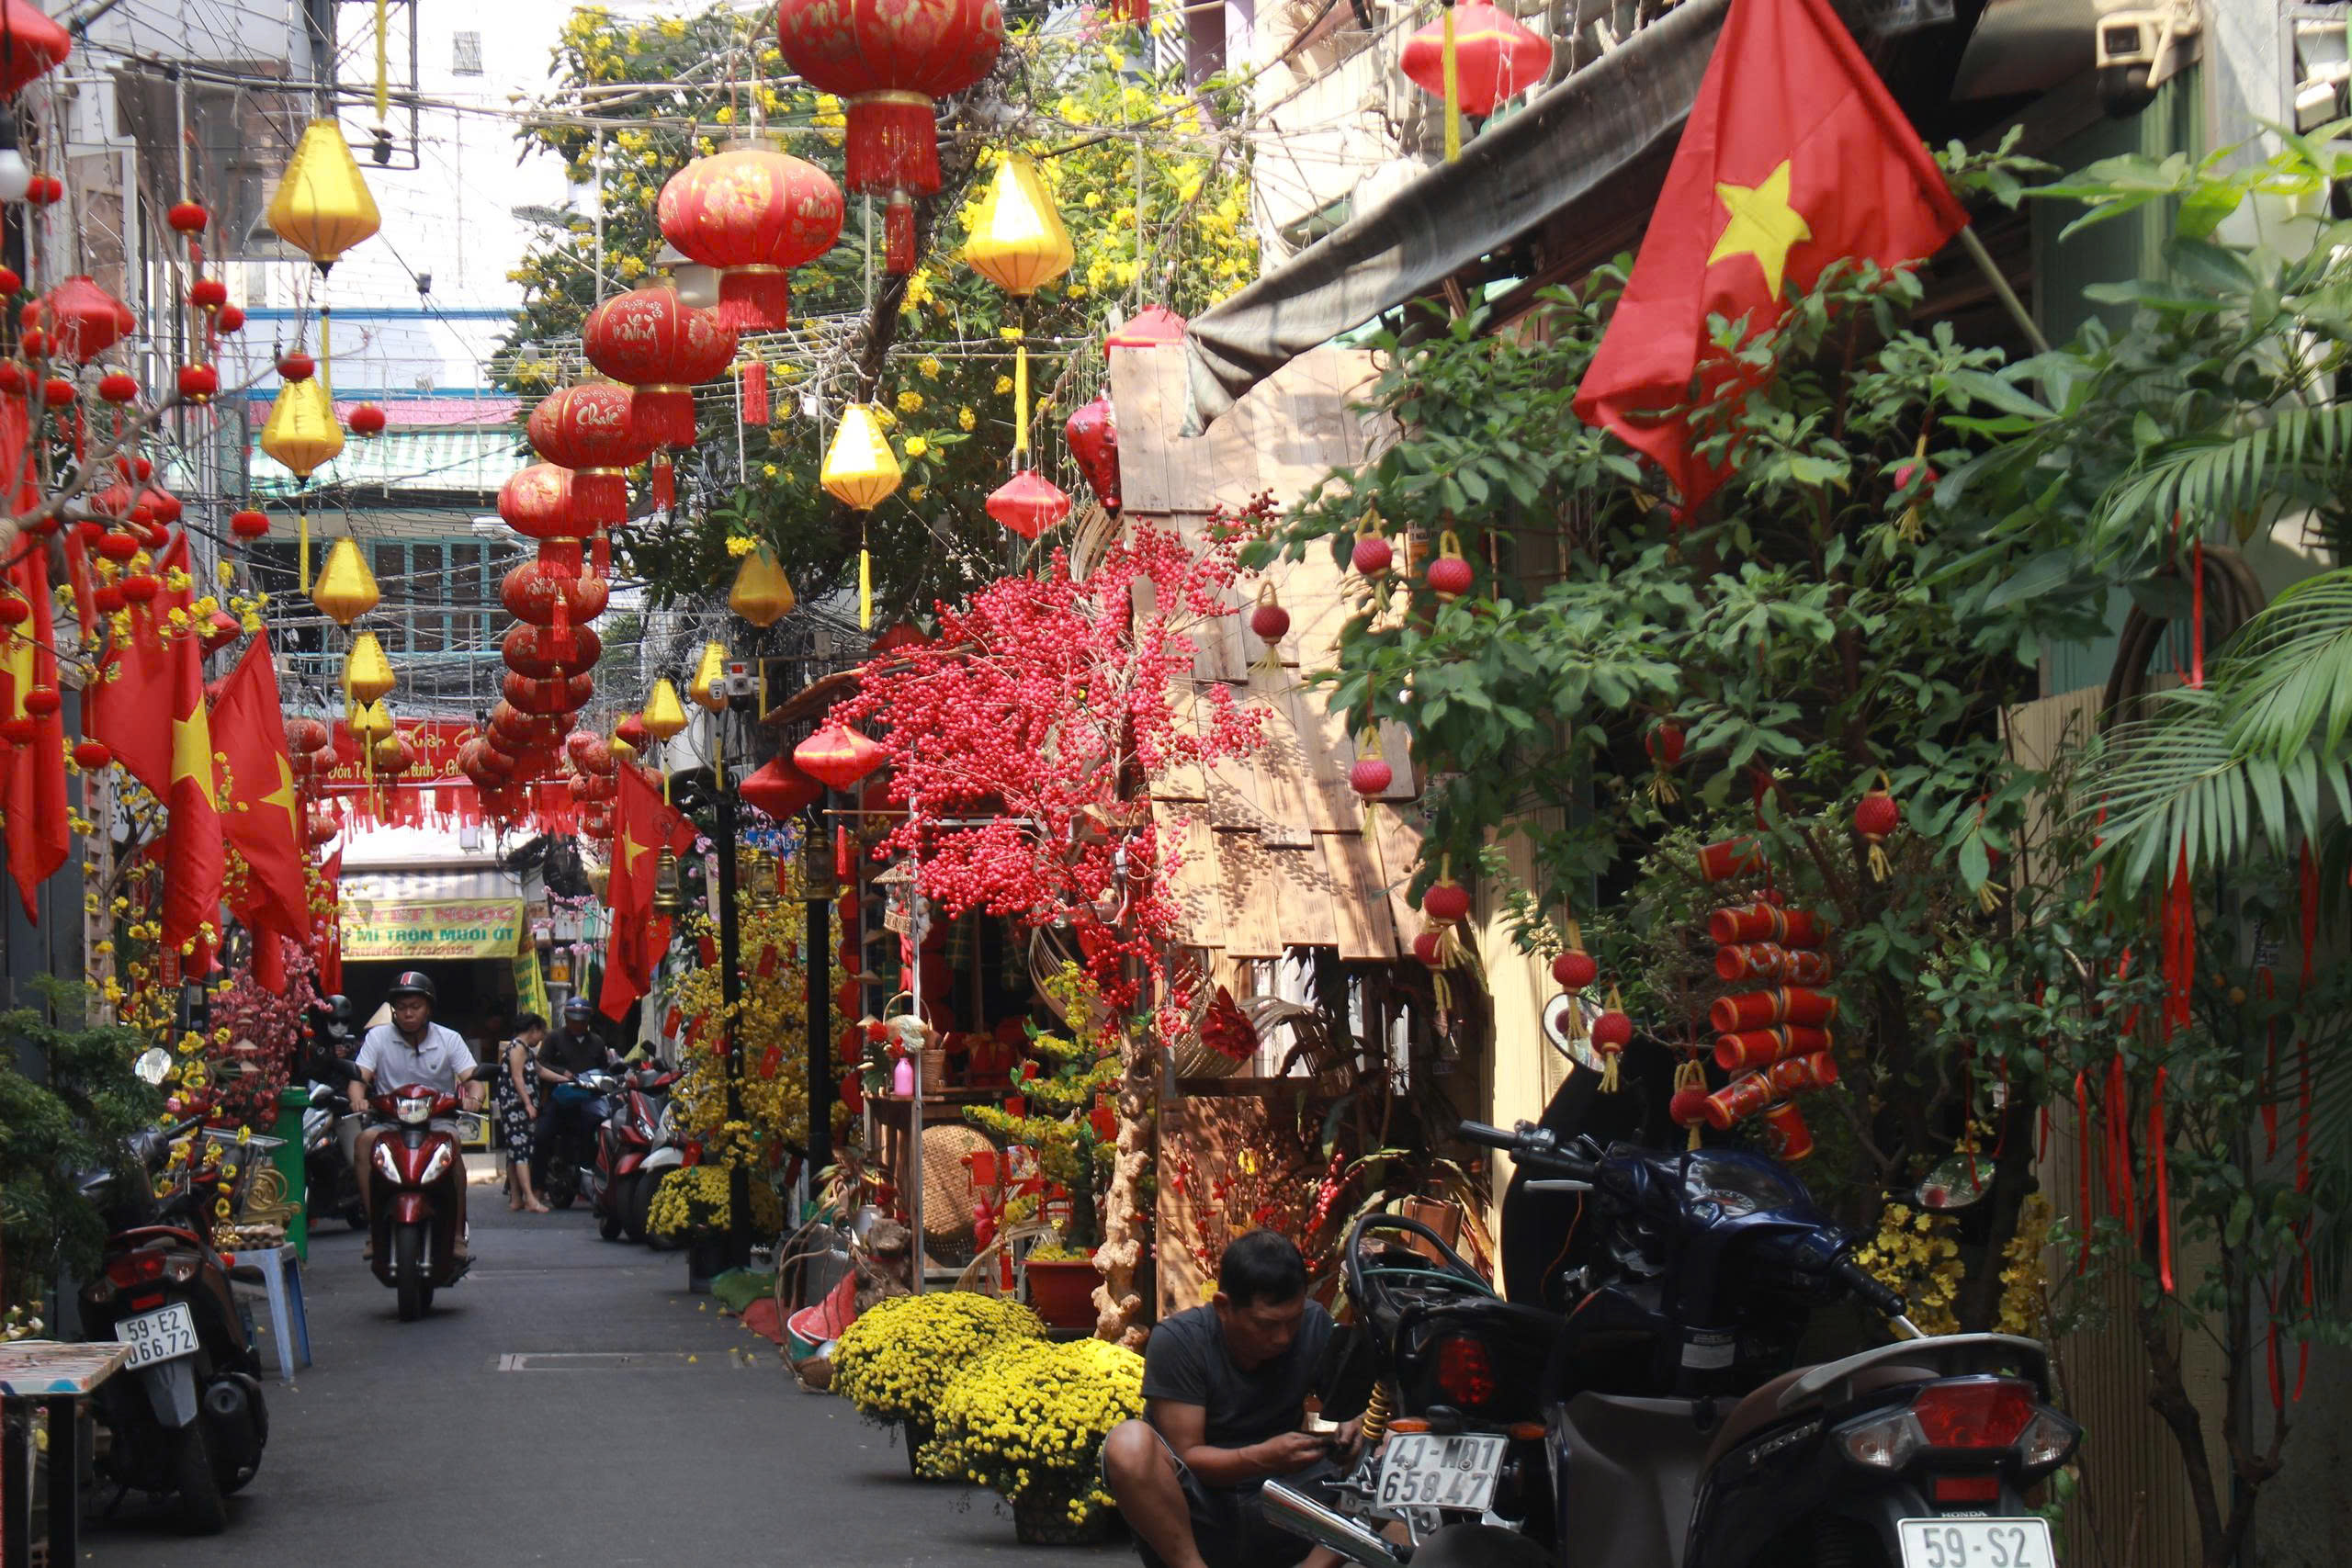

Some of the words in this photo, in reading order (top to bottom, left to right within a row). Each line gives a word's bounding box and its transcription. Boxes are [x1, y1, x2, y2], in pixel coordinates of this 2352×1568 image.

[127, 1311, 180, 1341] 59-E2
[1383, 1471, 1488, 1505] 658.47
[1923, 1527, 2030, 1568] 59-S2
